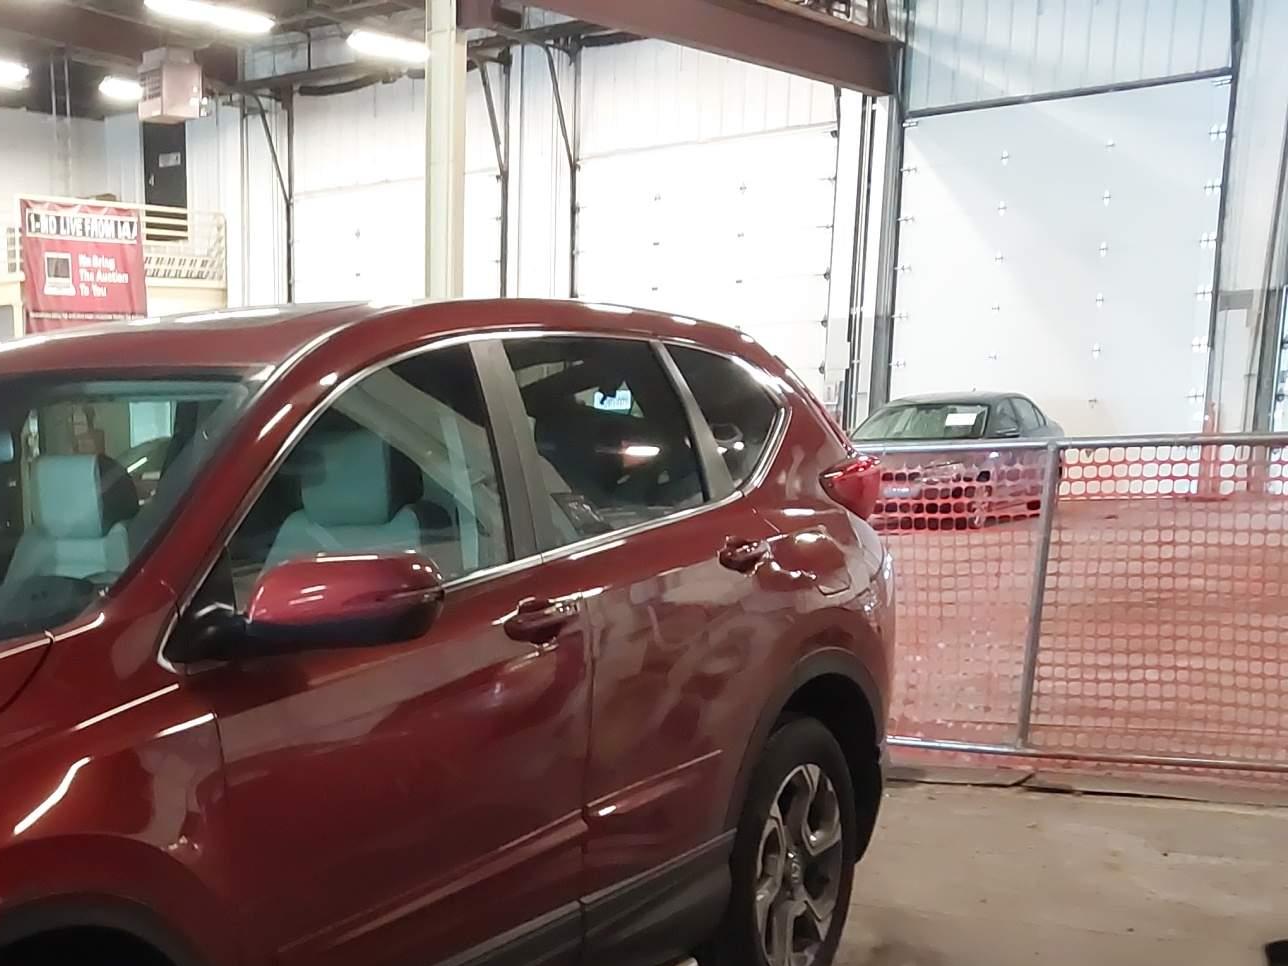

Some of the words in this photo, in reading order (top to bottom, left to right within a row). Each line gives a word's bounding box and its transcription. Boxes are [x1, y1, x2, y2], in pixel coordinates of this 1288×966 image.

[60, 214, 83, 237] LIVE
[84, 216, 115, 239] FROM
[92, 254, 115, 271] Bring
[79, 268, 94, 282] The
[95, 269, 128, 284] Auction
[79, 282, 89, 297] To
[91, 283, 107, 297] You
